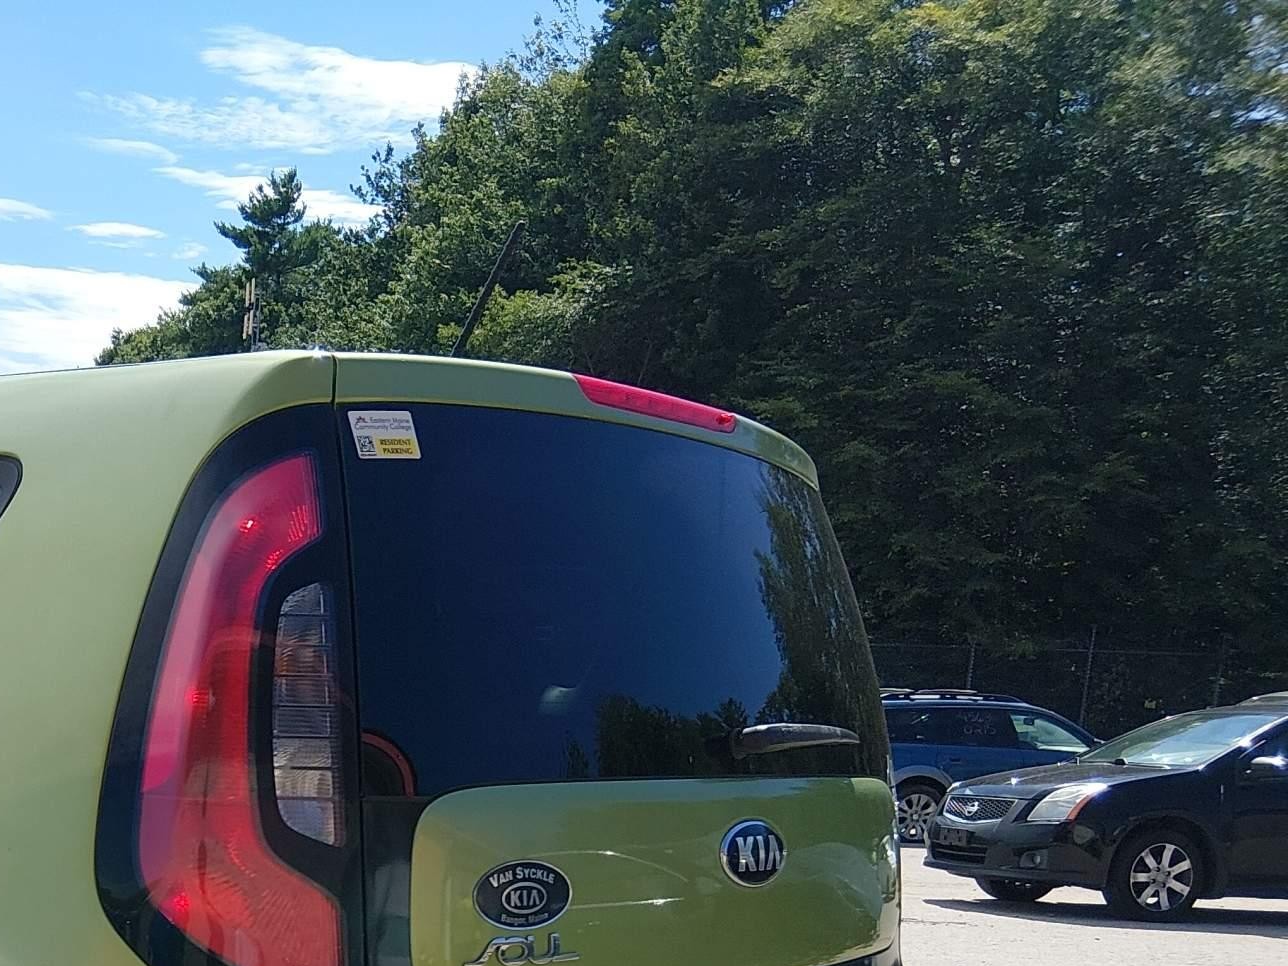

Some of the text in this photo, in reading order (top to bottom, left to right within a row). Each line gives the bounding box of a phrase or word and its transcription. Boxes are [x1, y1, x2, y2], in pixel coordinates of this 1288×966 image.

[379, 438, 412, 446] RESIDENT
[382, 447, 414, 455] PARKING
[735, 834, 781, 872] KIA
[510, 889, 541, 907] KIA
